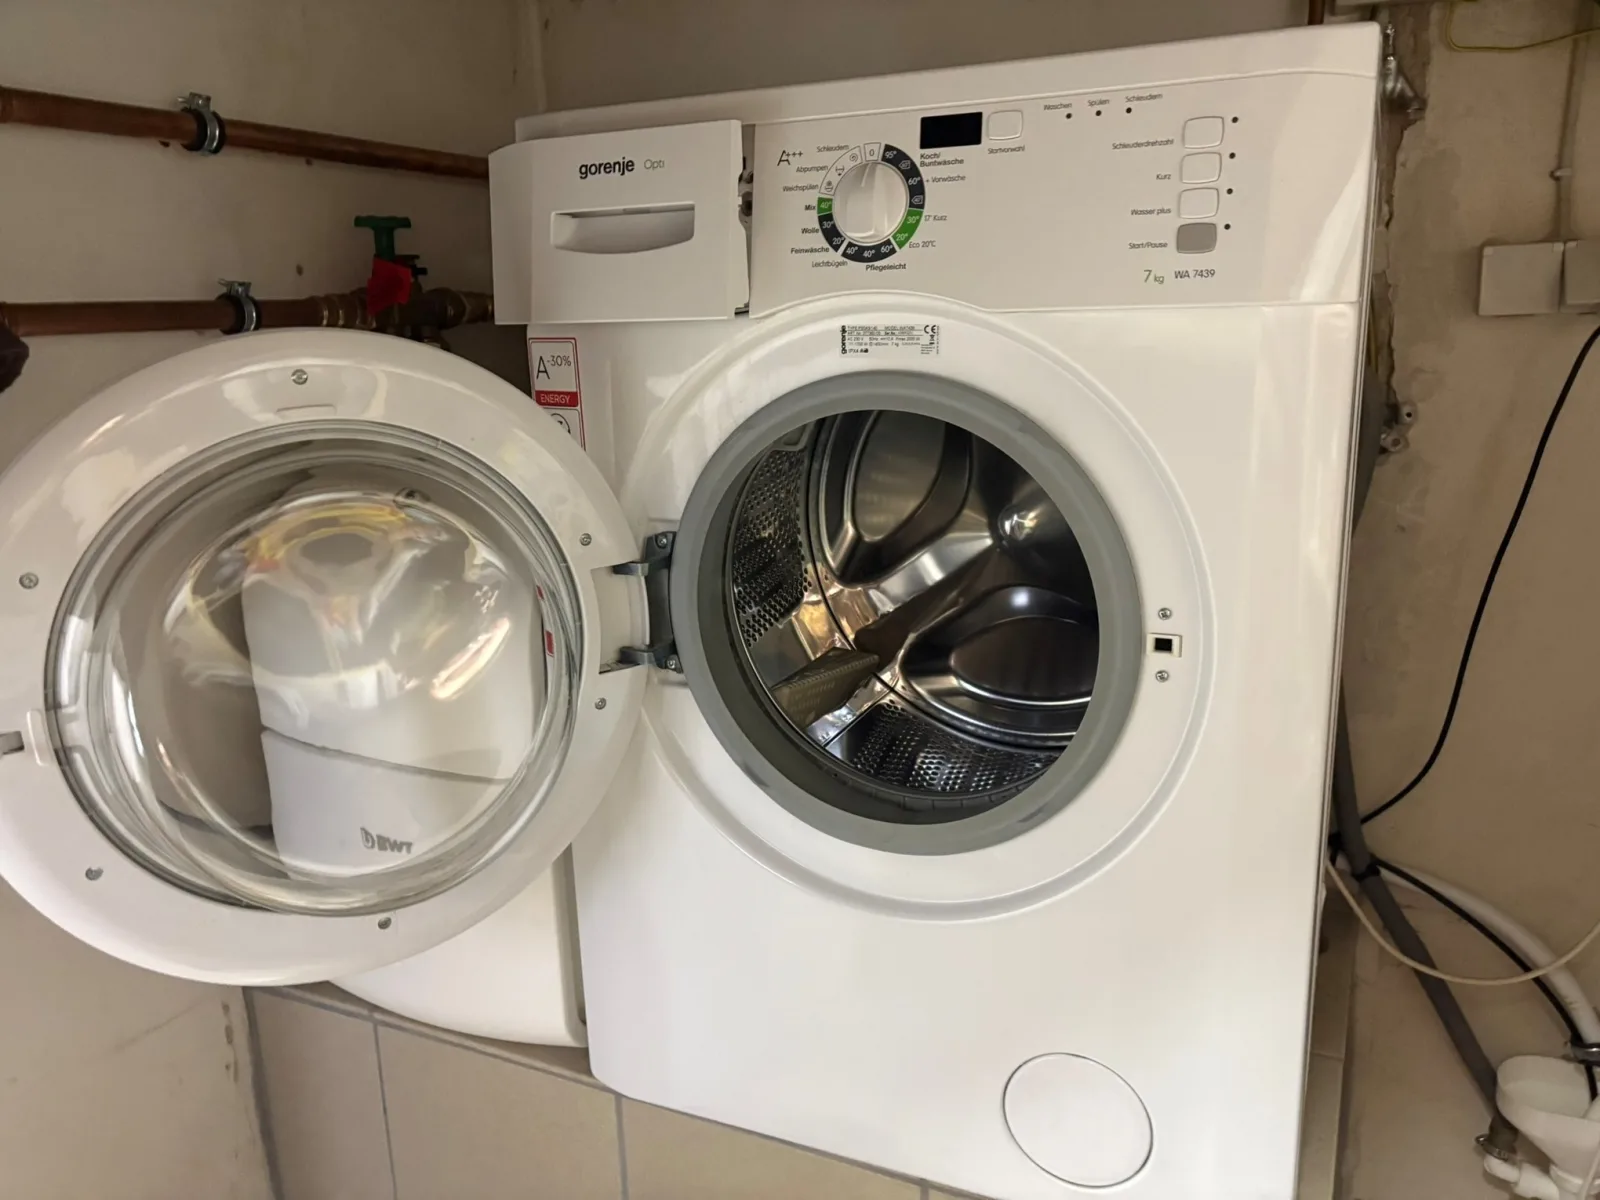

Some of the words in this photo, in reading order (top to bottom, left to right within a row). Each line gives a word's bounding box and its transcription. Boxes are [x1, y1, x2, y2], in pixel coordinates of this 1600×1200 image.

[1125, 92, 1163, 103] Schleudern
[1043, 102, 1073, 111] Waschen
[1087, 98, 1110, 107] Spülen
[816, 144, 849, 153] Schleudern
[1111, 138, 1174, 150] Schleuderdrehzahl
[868, 148, 875, 157] 0
[884, 150, 897, 159] 95°
[987, 145, 1026, 155] Startvorwahl
[776, 150, 804, 166] A+++
[920, 158, 964, 168] Buntwäsche
[578, 156, 635, 180] gorenje
[795, 165, 829, 174] Abpumpen
[908, 176, 921, 185] 60°
[931, 174, 966, 183] Vorwäsche
[1155, 173, 1172, 181] Kurz
[782, 183, 819, 193] Weichspülen
[819, 200, 832, 209] 40°
[1130, 208, 1155, 216] Wasser
[1156, 207, 1172, 216] plus
[906, 215, 920, 224] 30°
[822, 220, 834, 229] 30°
[801, 227, 820, 235] Wolle
[832, 236, 845, 246] 20°
[896, 232, 909, 242] 20°
[881, 244, 893, 253] 60°
[908, 241, 920, 249] Eco
[921, 240, 936, 248] 20°C
[1128, 241, 1169, 250] Start/Pause
[790, 247, 830, 255] Feinwäsche
[846, 246, 858, 255] 40°
[863, 249, 875, 258] 40°
[811, 259, 849, 269] Leichtbügeln
[865, 262, 907, 273] Pflegeleicht
[1143, 269, 1153, 283] 7
[1153, 274, 1165, 285] kg
[1174, 270, 1190, 279] WA
[1192, 268, 1216, 279] 7439
[540, 393, 571, 404] ENERGY
[376, 834, 413, 855] BWT
